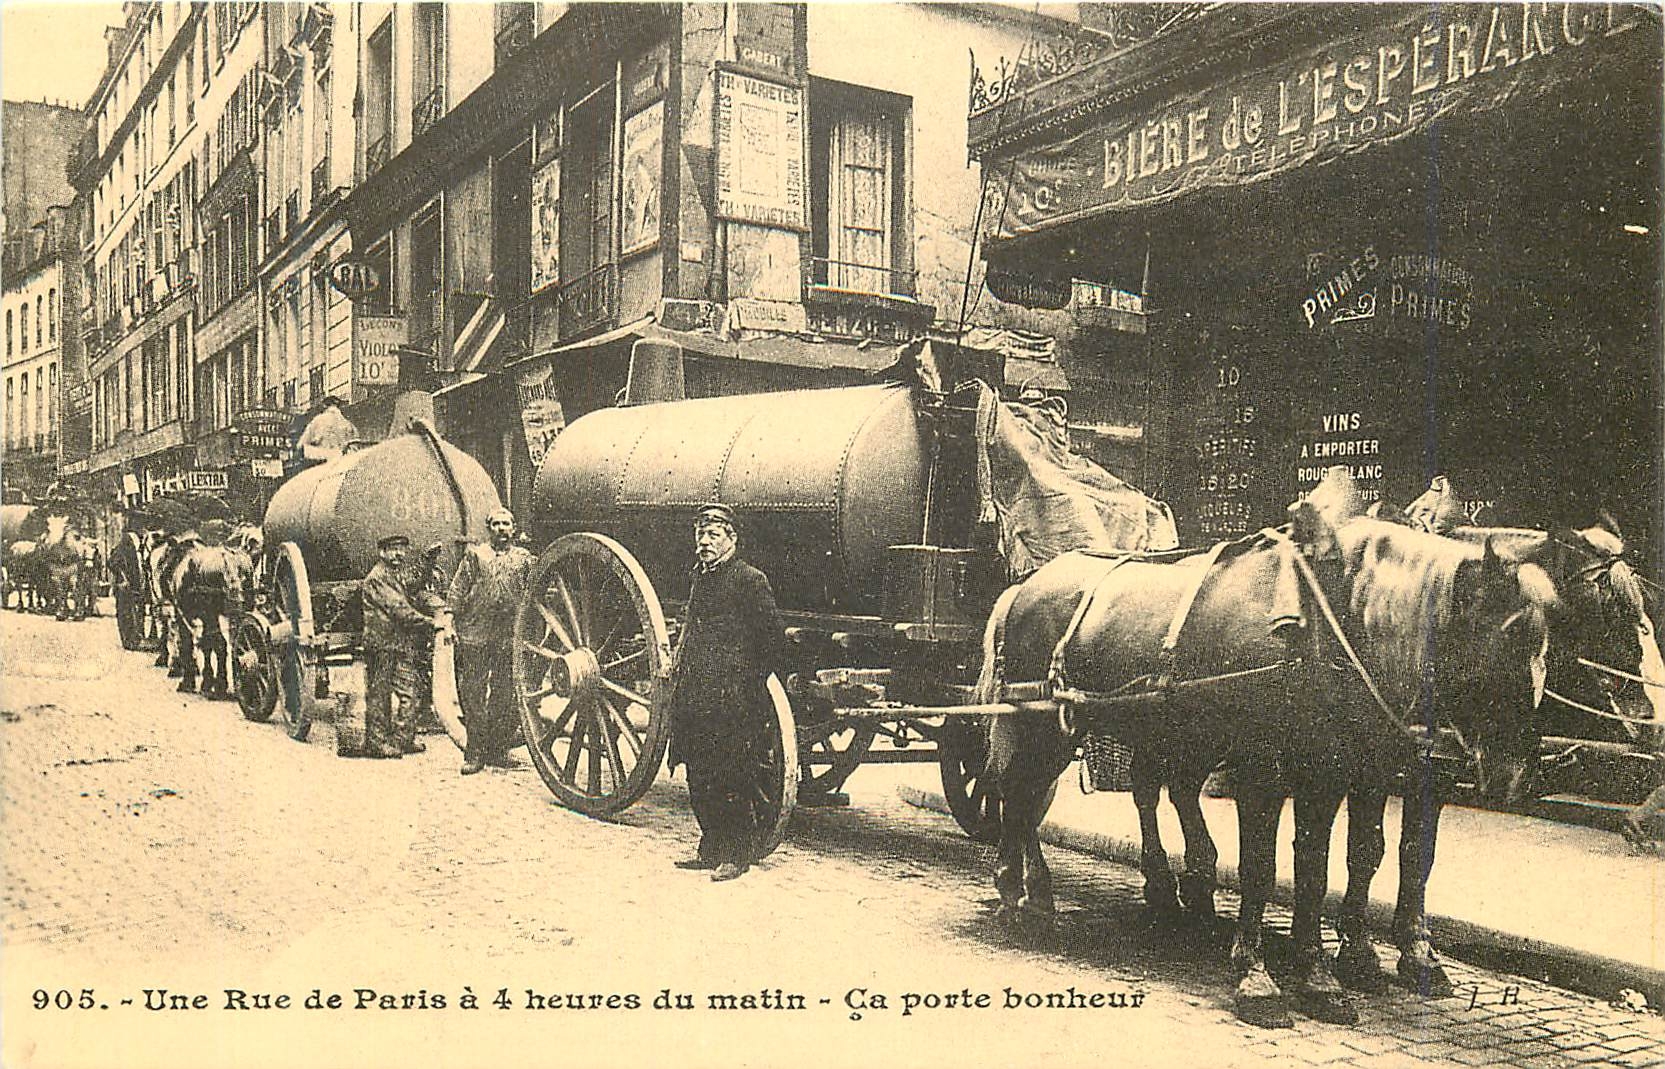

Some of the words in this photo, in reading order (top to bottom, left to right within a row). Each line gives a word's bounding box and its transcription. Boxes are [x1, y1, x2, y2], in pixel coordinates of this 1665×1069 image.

[1222, 96, 1264, 151] de
[1301, 247, 1379, 329] PRIMES
[1218, 366, 1240, 388] 10
[1322, 412, 1361, 433] VINS
[1301, 444, 1309, 459] A
[1314, 439, 1380, 458] EMPORTER
[1297, 466, 1329, 482] ROUG
[1346, 464, 1384, 480] LANC
